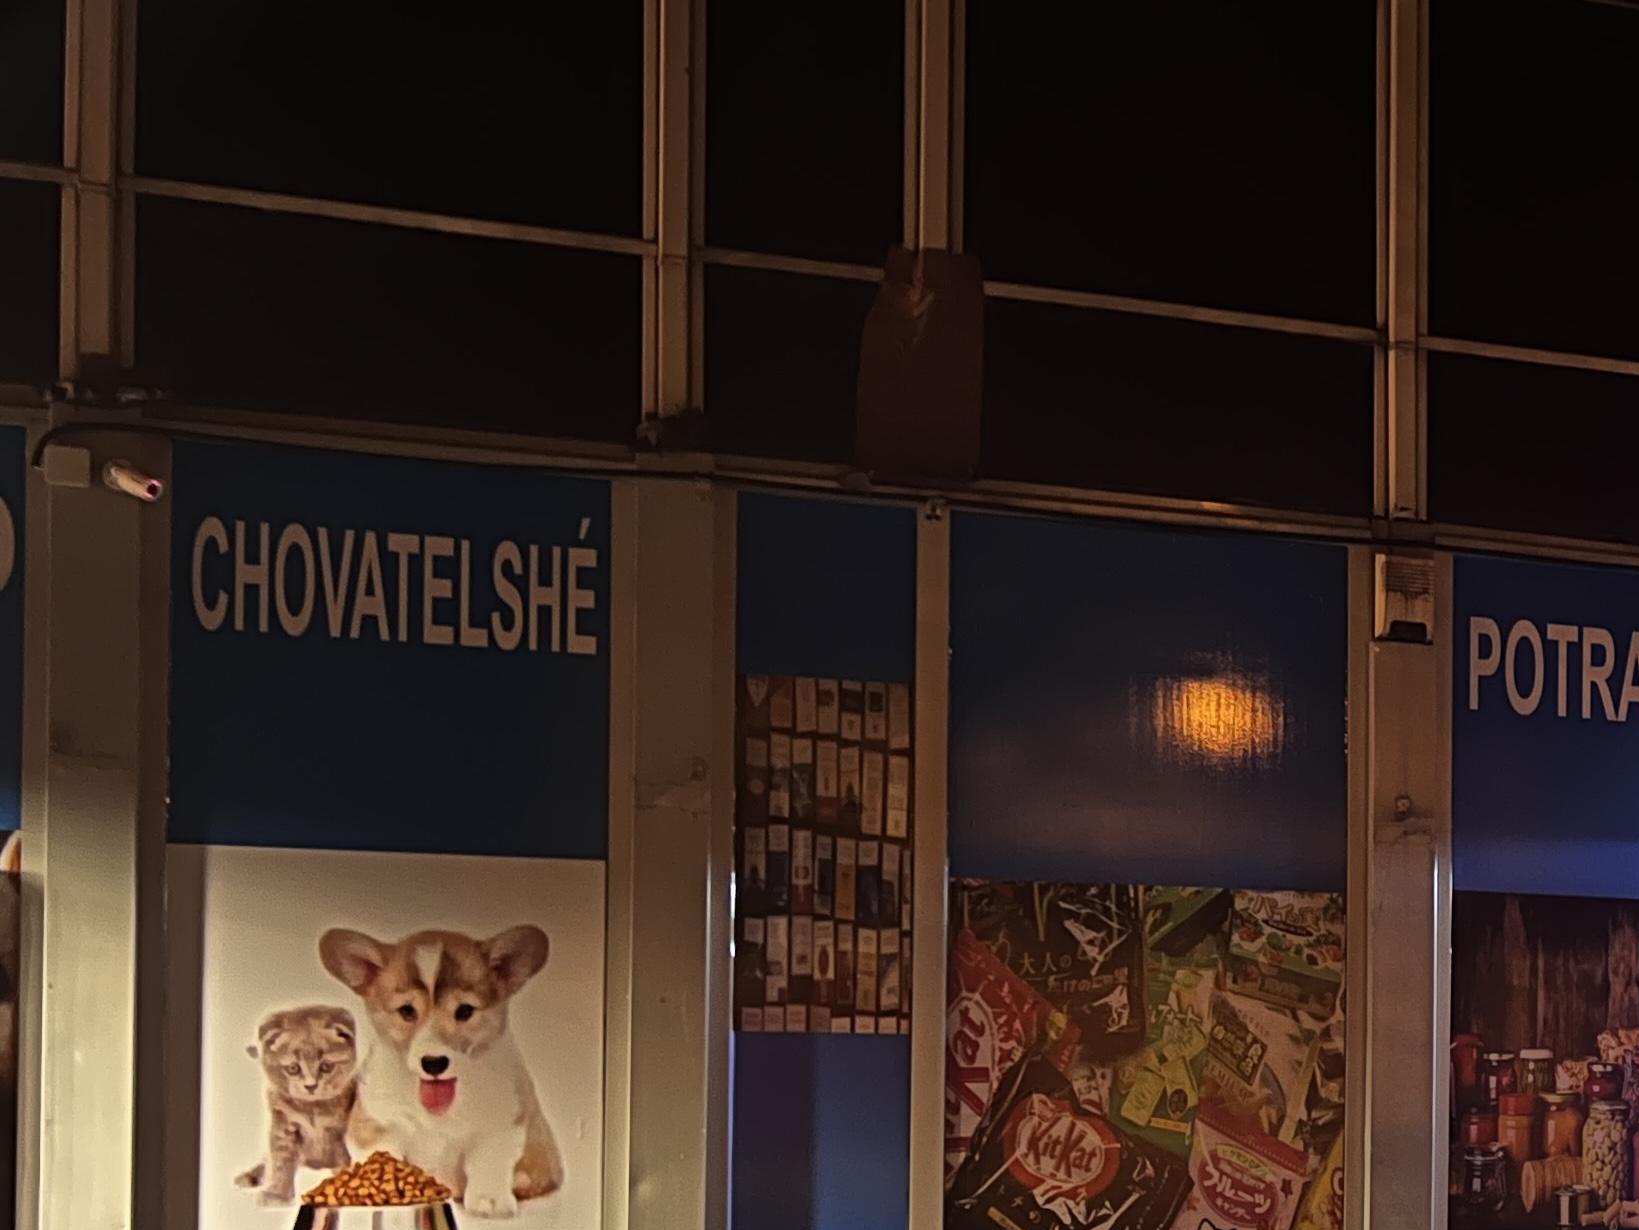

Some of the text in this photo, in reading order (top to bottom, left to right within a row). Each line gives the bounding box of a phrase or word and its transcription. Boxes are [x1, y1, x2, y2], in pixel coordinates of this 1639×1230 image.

[192, 516, 597, 655] CHOVATELSHÉ
[1018, 951, 1072, 977] 大人の
[1024, 1115, 1097, 1178] KitKat
